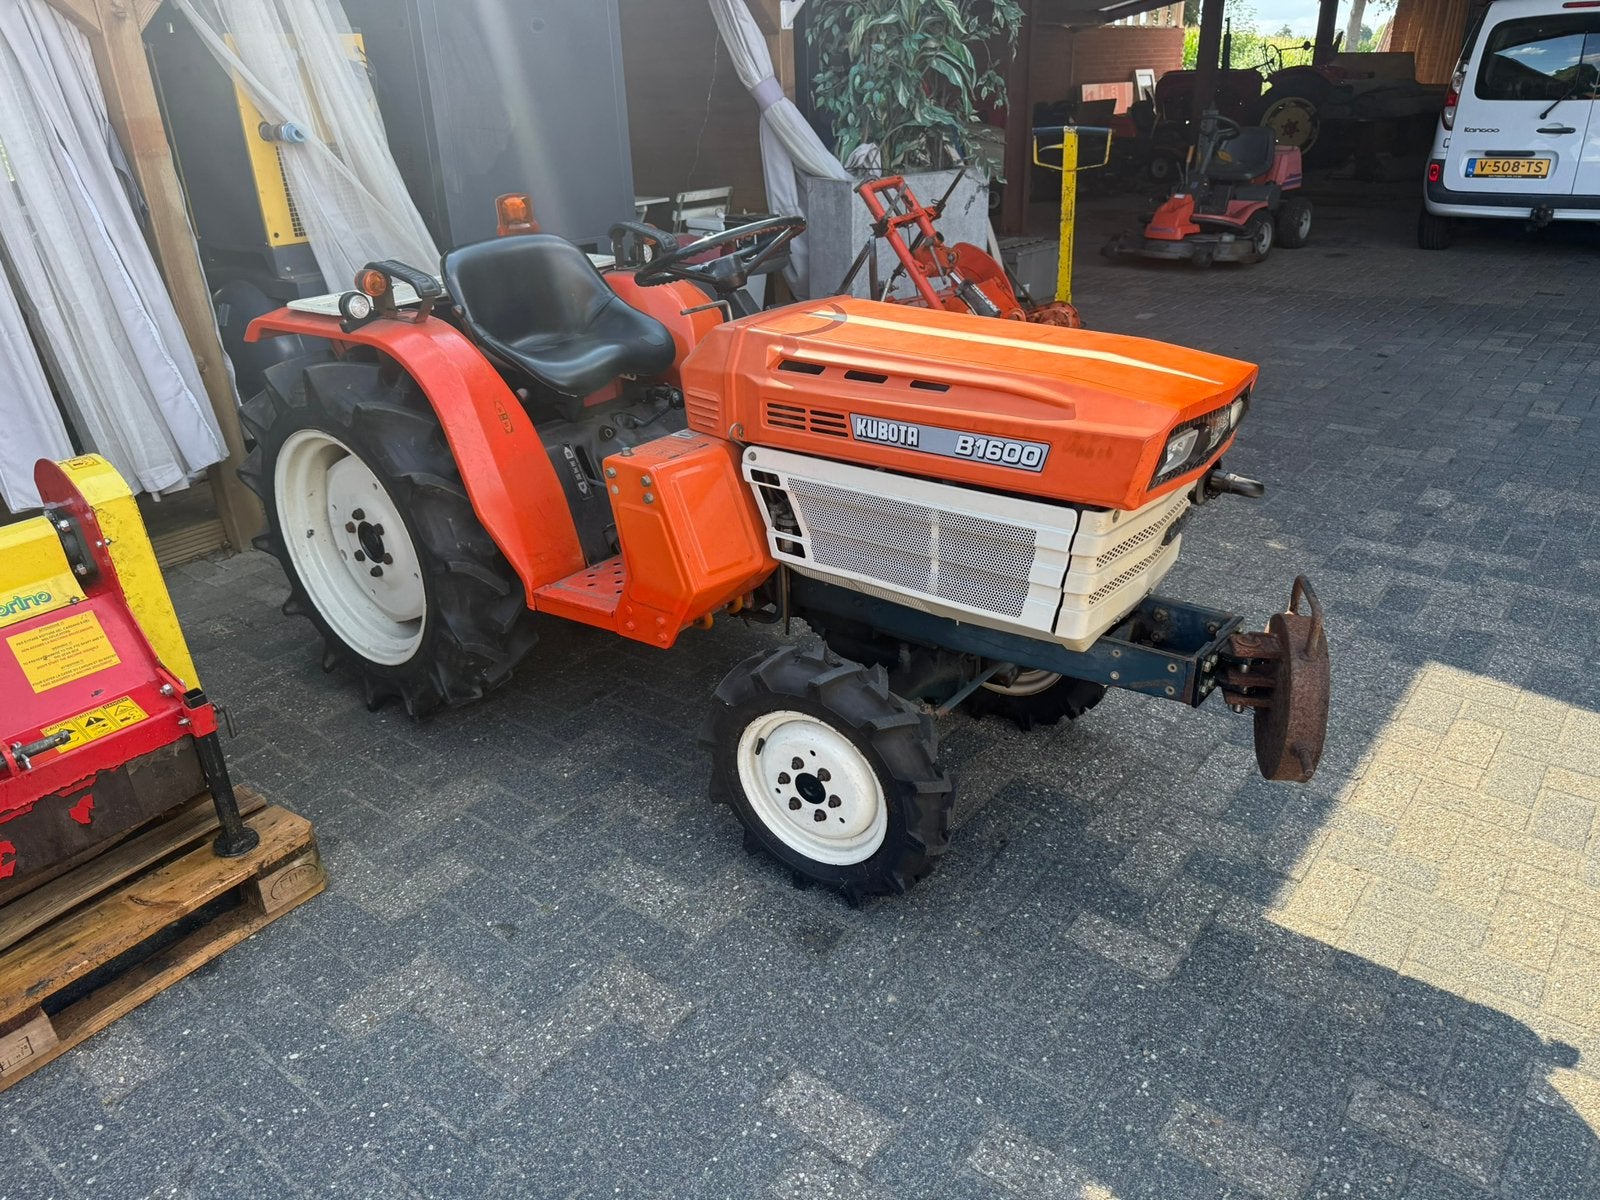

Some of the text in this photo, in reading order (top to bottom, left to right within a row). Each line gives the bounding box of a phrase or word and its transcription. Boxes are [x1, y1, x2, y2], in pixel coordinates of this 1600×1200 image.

[1479, 160, 1544, 173] V-508-TS
[855, 417, 920, 449] KUBOTA
[954, 434, 1043, 468] B1600
